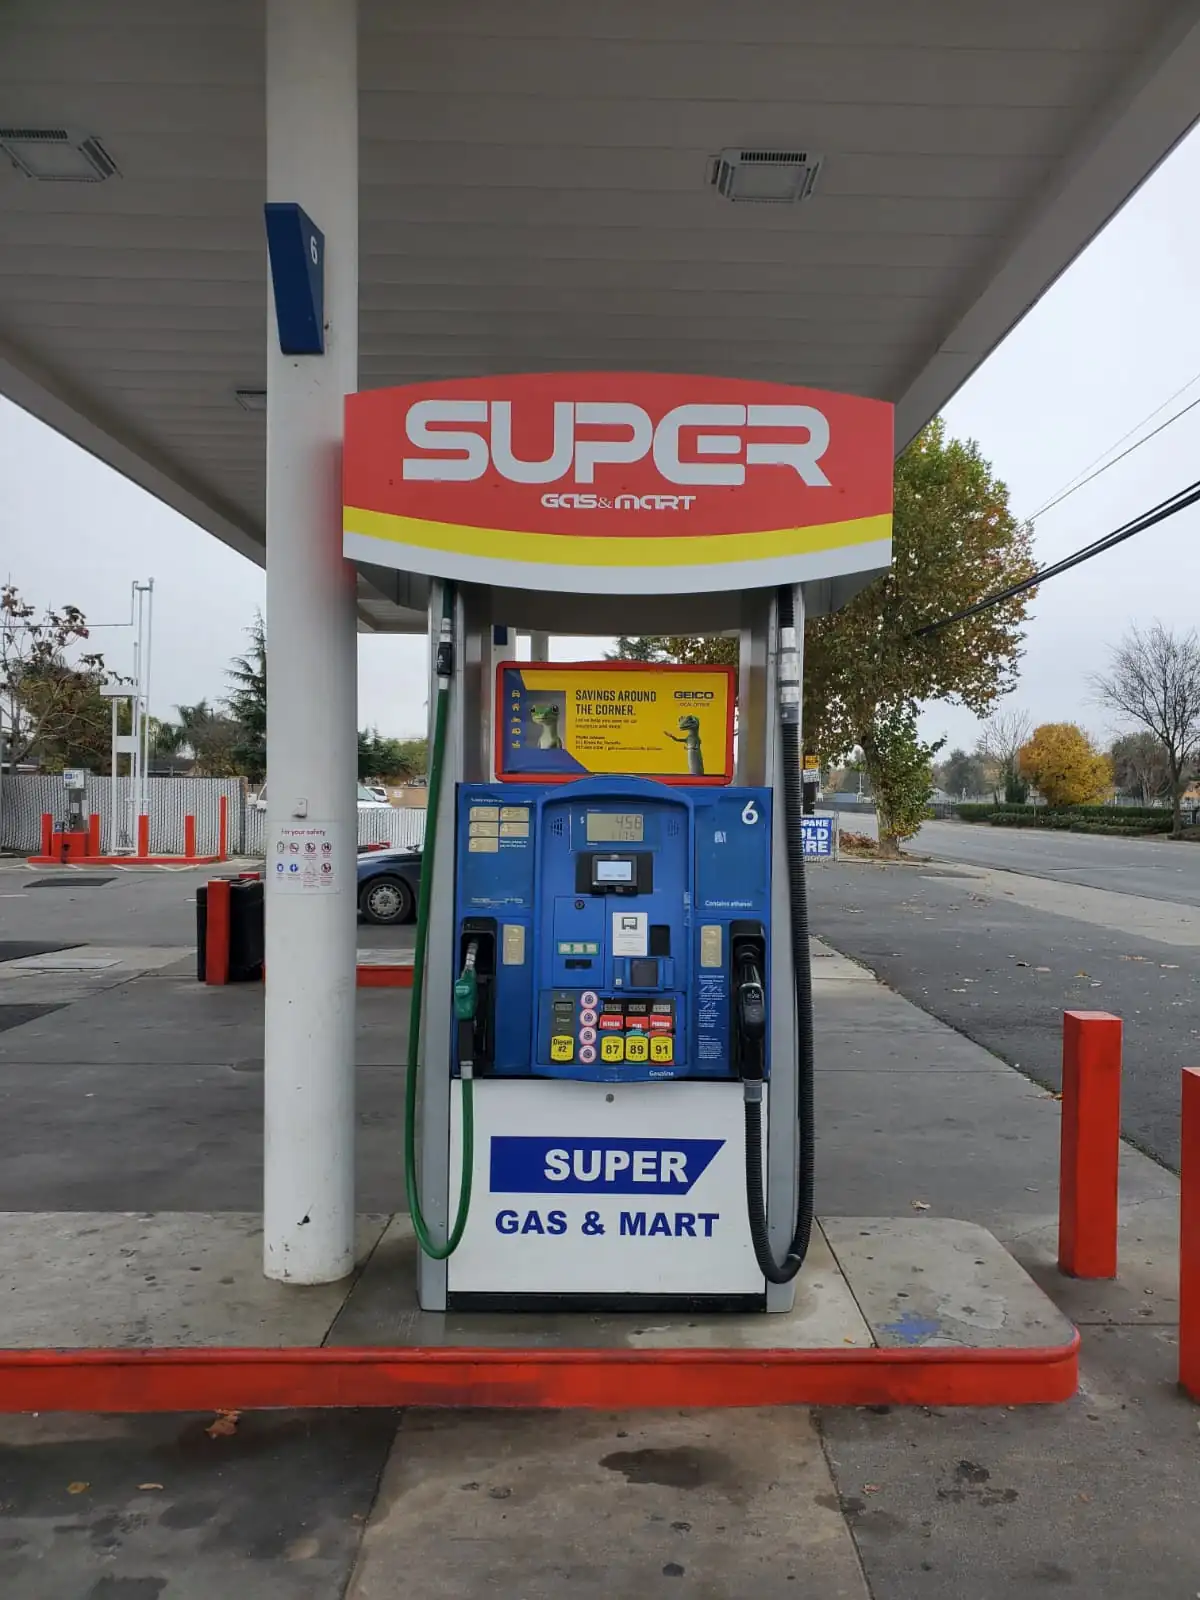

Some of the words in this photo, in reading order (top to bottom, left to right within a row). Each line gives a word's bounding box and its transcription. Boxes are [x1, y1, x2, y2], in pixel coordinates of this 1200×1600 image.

[310, 235, 318, 265] 6
[402, 399, 832, 487] SUPER
[575, 689, 616, 702] SAVINGS
[618, 690, 657, 702] AROUND
[673, 690, 715, 700] GEICO
[575, 703, 593, 716] THE
[595, 704, 637, 716] CORNER.
[741, 800, 759, 825] 6
[802, 819, 829, 827] PANE
[307, 828, 327, 836] safety
[802, 840, 829, 853] RE
[606, 1044, 620, 1055] 87
[630, 1044, 644, 1055] 89
[655, 1044, 668, 1055] 91
[543, 1148, 689, 1183] SUPER
[495, 1209, 568, 1235] GAS
[581, 1210, 606, 1236] &
[619, 1211, 720, 1238] MART
